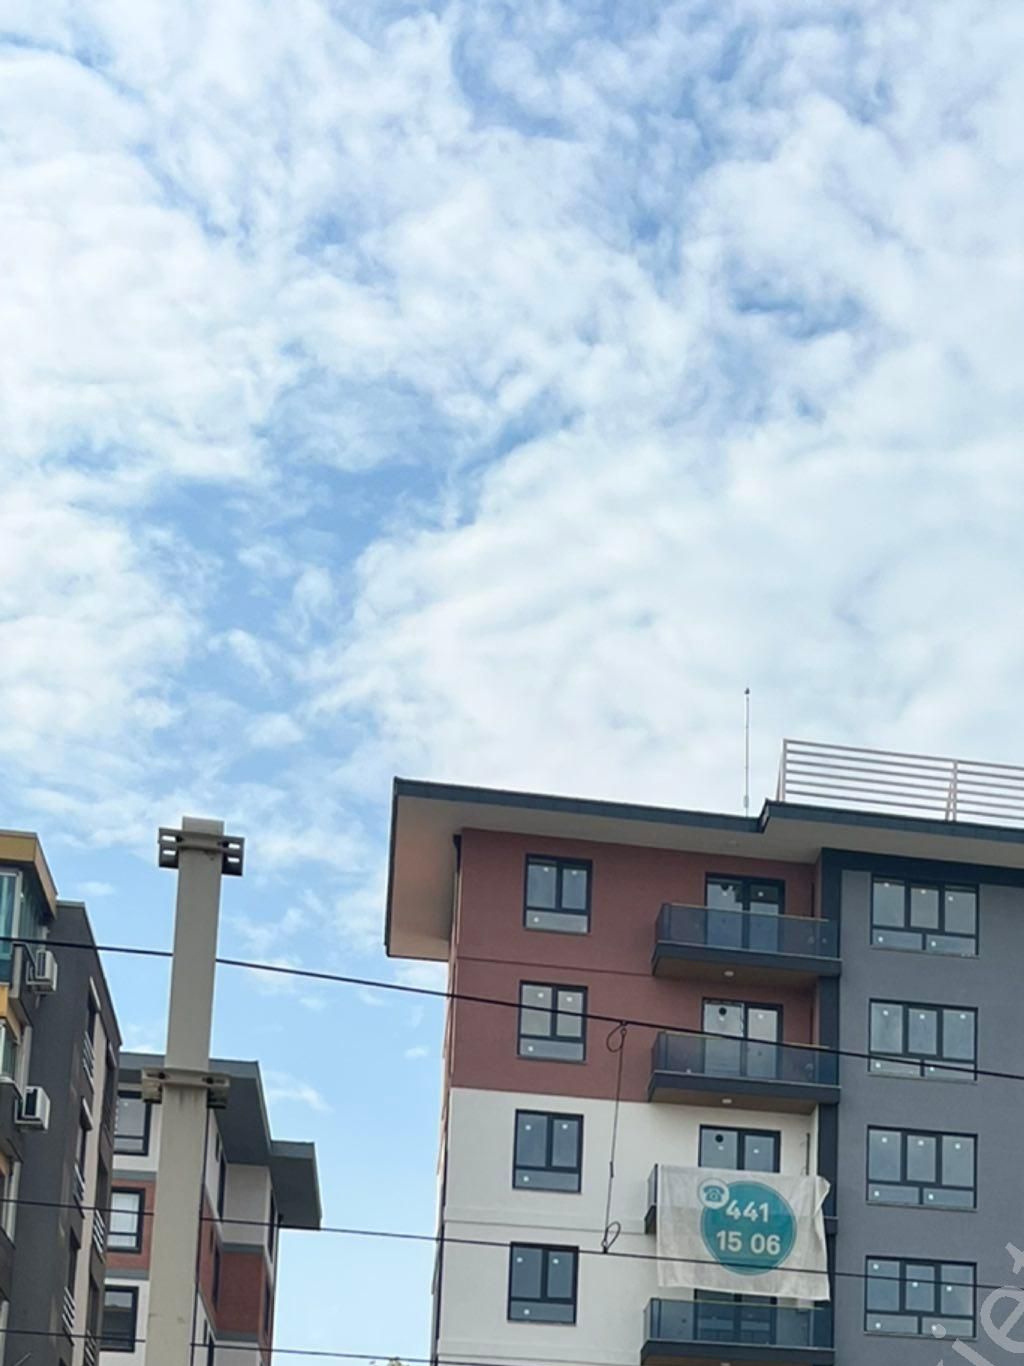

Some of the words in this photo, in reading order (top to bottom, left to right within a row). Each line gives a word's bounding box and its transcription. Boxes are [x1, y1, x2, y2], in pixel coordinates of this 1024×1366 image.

[725, 1199, 769, 1223] 441
[716, 1230, 742, 1252] 15
[750, 1233, 781, 1255] 06
